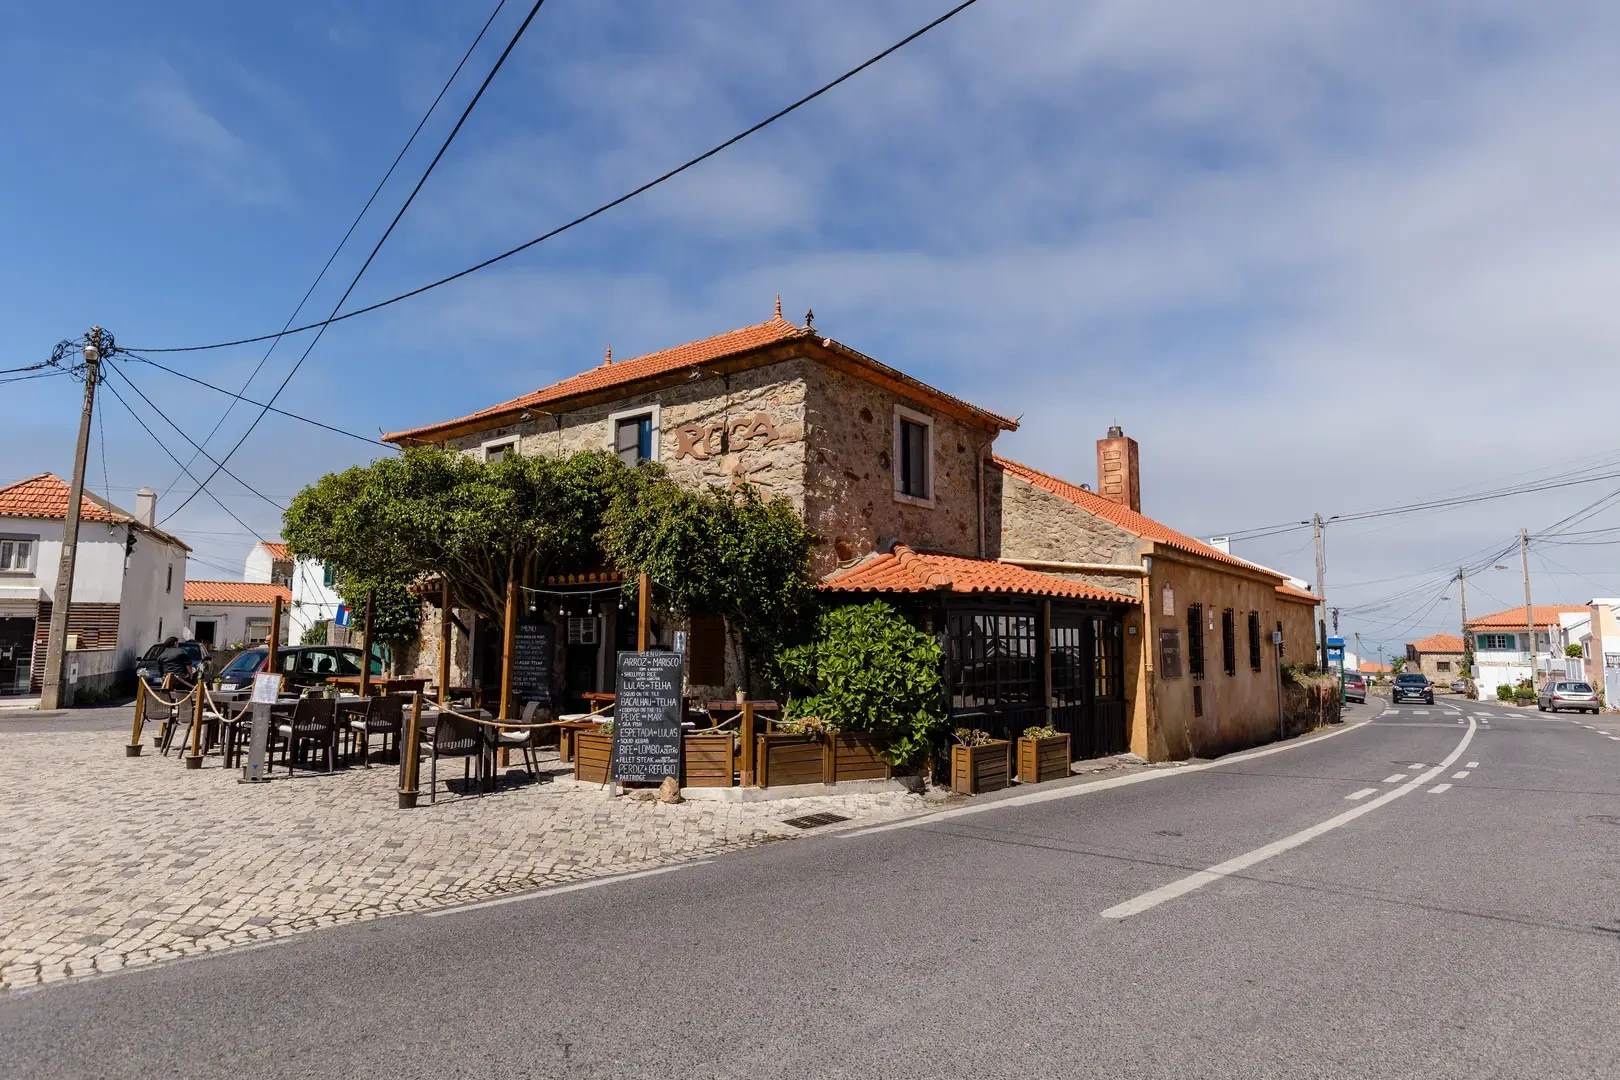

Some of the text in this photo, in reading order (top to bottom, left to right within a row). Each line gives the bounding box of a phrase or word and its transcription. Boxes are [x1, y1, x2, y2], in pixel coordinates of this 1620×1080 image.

[674, 413, 779, 460] ROCA
[623, 658, 647, 667] ARROZ
[653, 658, 679, 667] MARISCO
[623, 681, 645, 690] LULAS
[650, 681, 672, 690] TELHA
[621, 698, 651, 706] BACALHAU
[655, 698, 677, 706] TELHA
[620, 712, 641, 721] PEIXE
[647, 712, 662, 721] MAR
[620, 728, 654, 737] ESPETADA
[657, 728, 678, 738] LULAS
[619, 745, 633, 754] BIFE
[638, 745, 660, 754] LOMBO
[619, 764, 644, 774] PERDIZ
[648, 763, 675, 774] REFÚGIO
